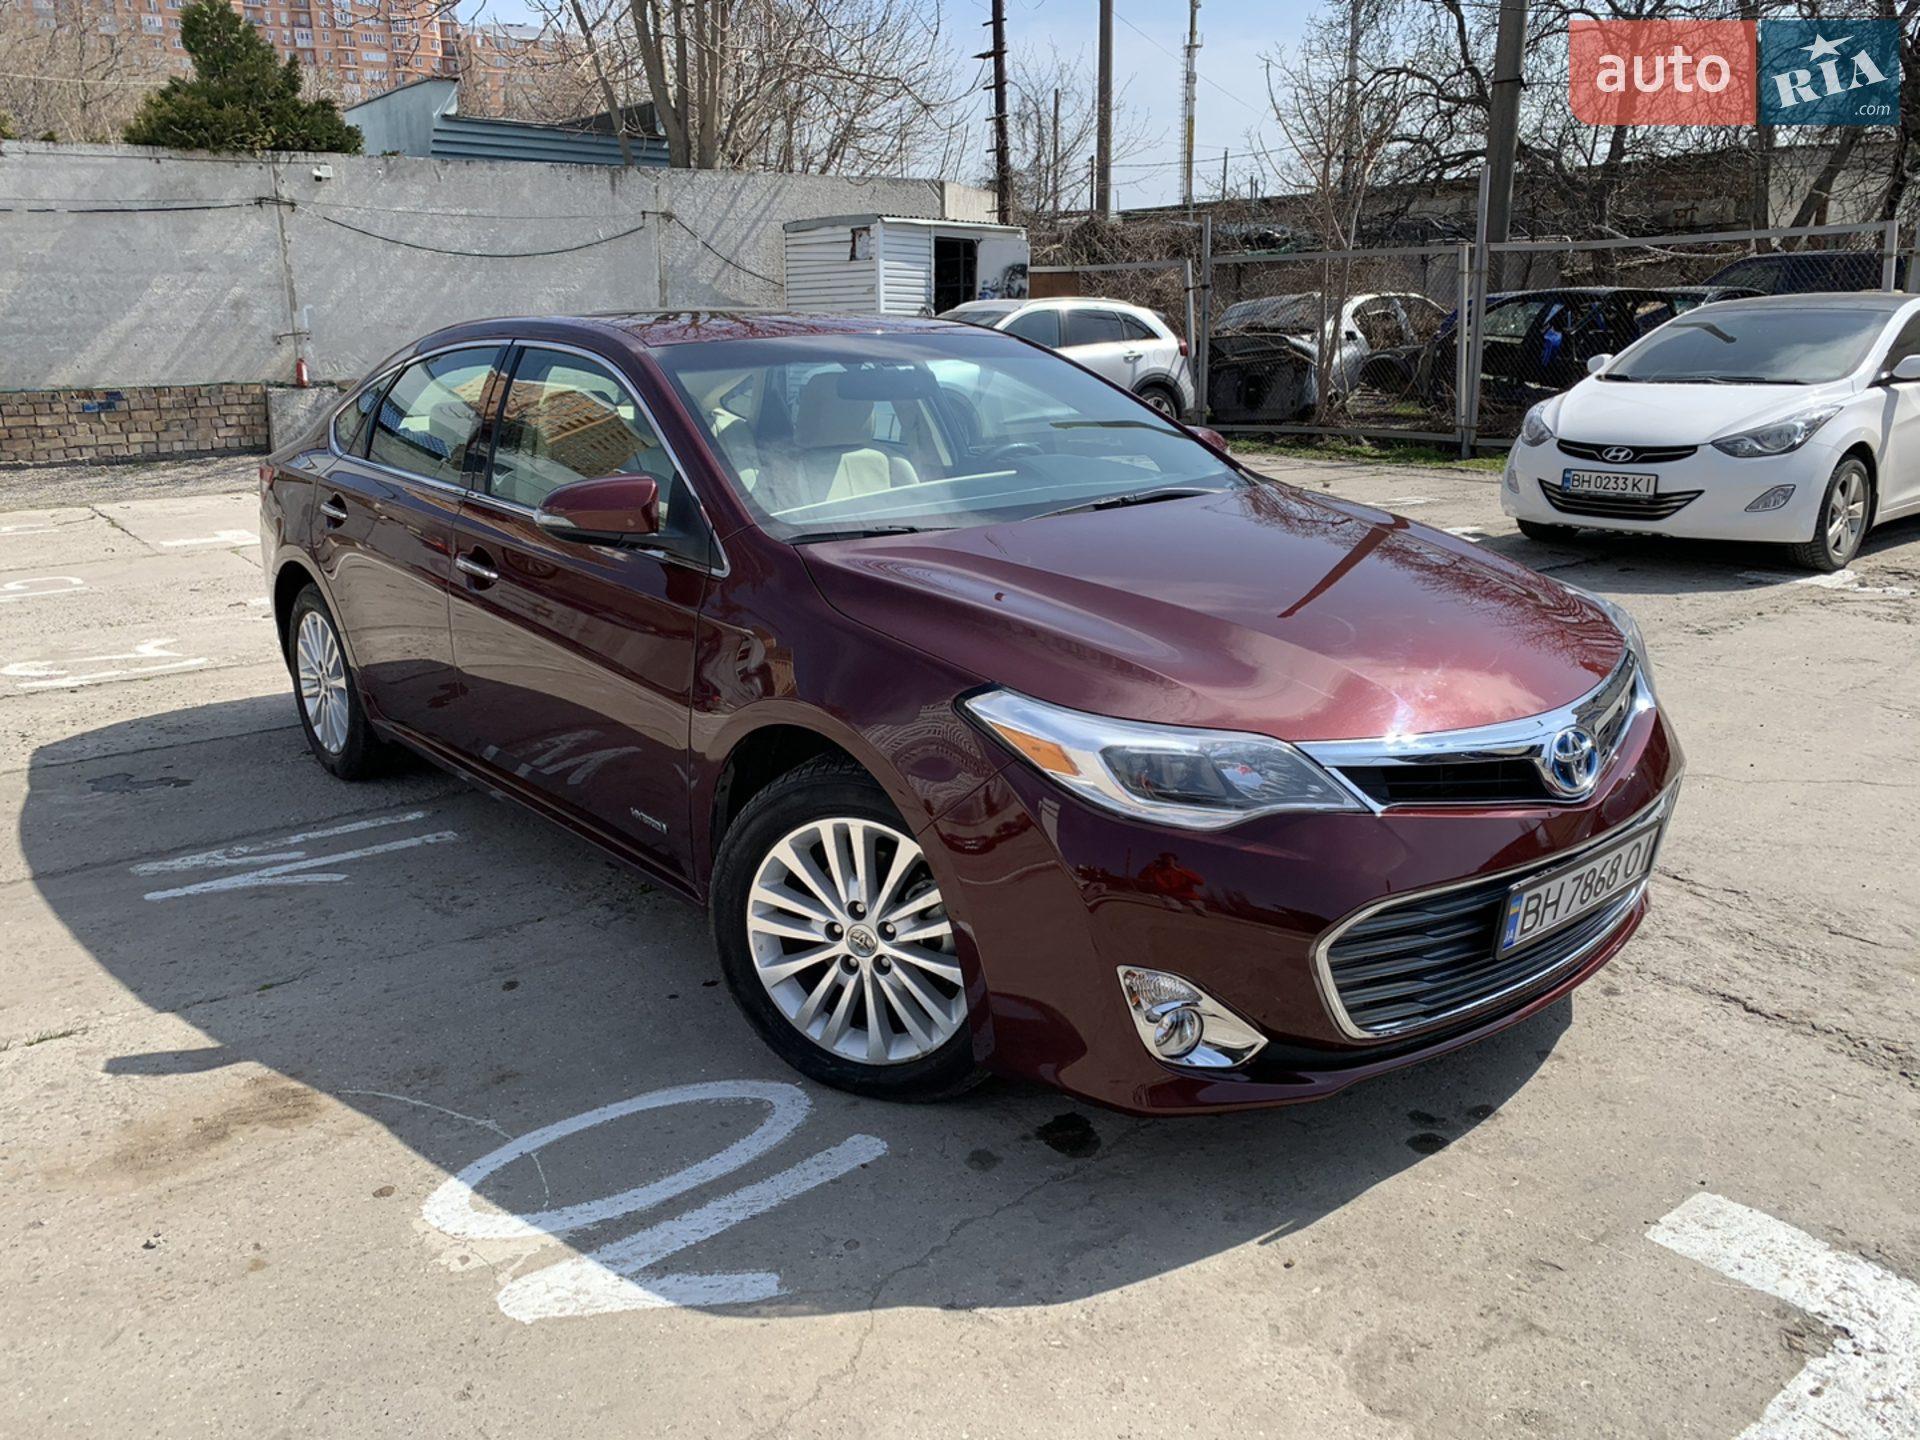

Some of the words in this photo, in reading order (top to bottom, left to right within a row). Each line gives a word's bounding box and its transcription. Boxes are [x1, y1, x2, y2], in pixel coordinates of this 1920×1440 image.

[1571, 474, 1592, 488] BH
[1594, 475, 1629, 491] 0233
[1631, 477, 1651, 493] KI
[1519, 881, 1566, 937] BH
[1565, 853, 1623, 914] 7868
[1624, 834, 1653, 880] OI
